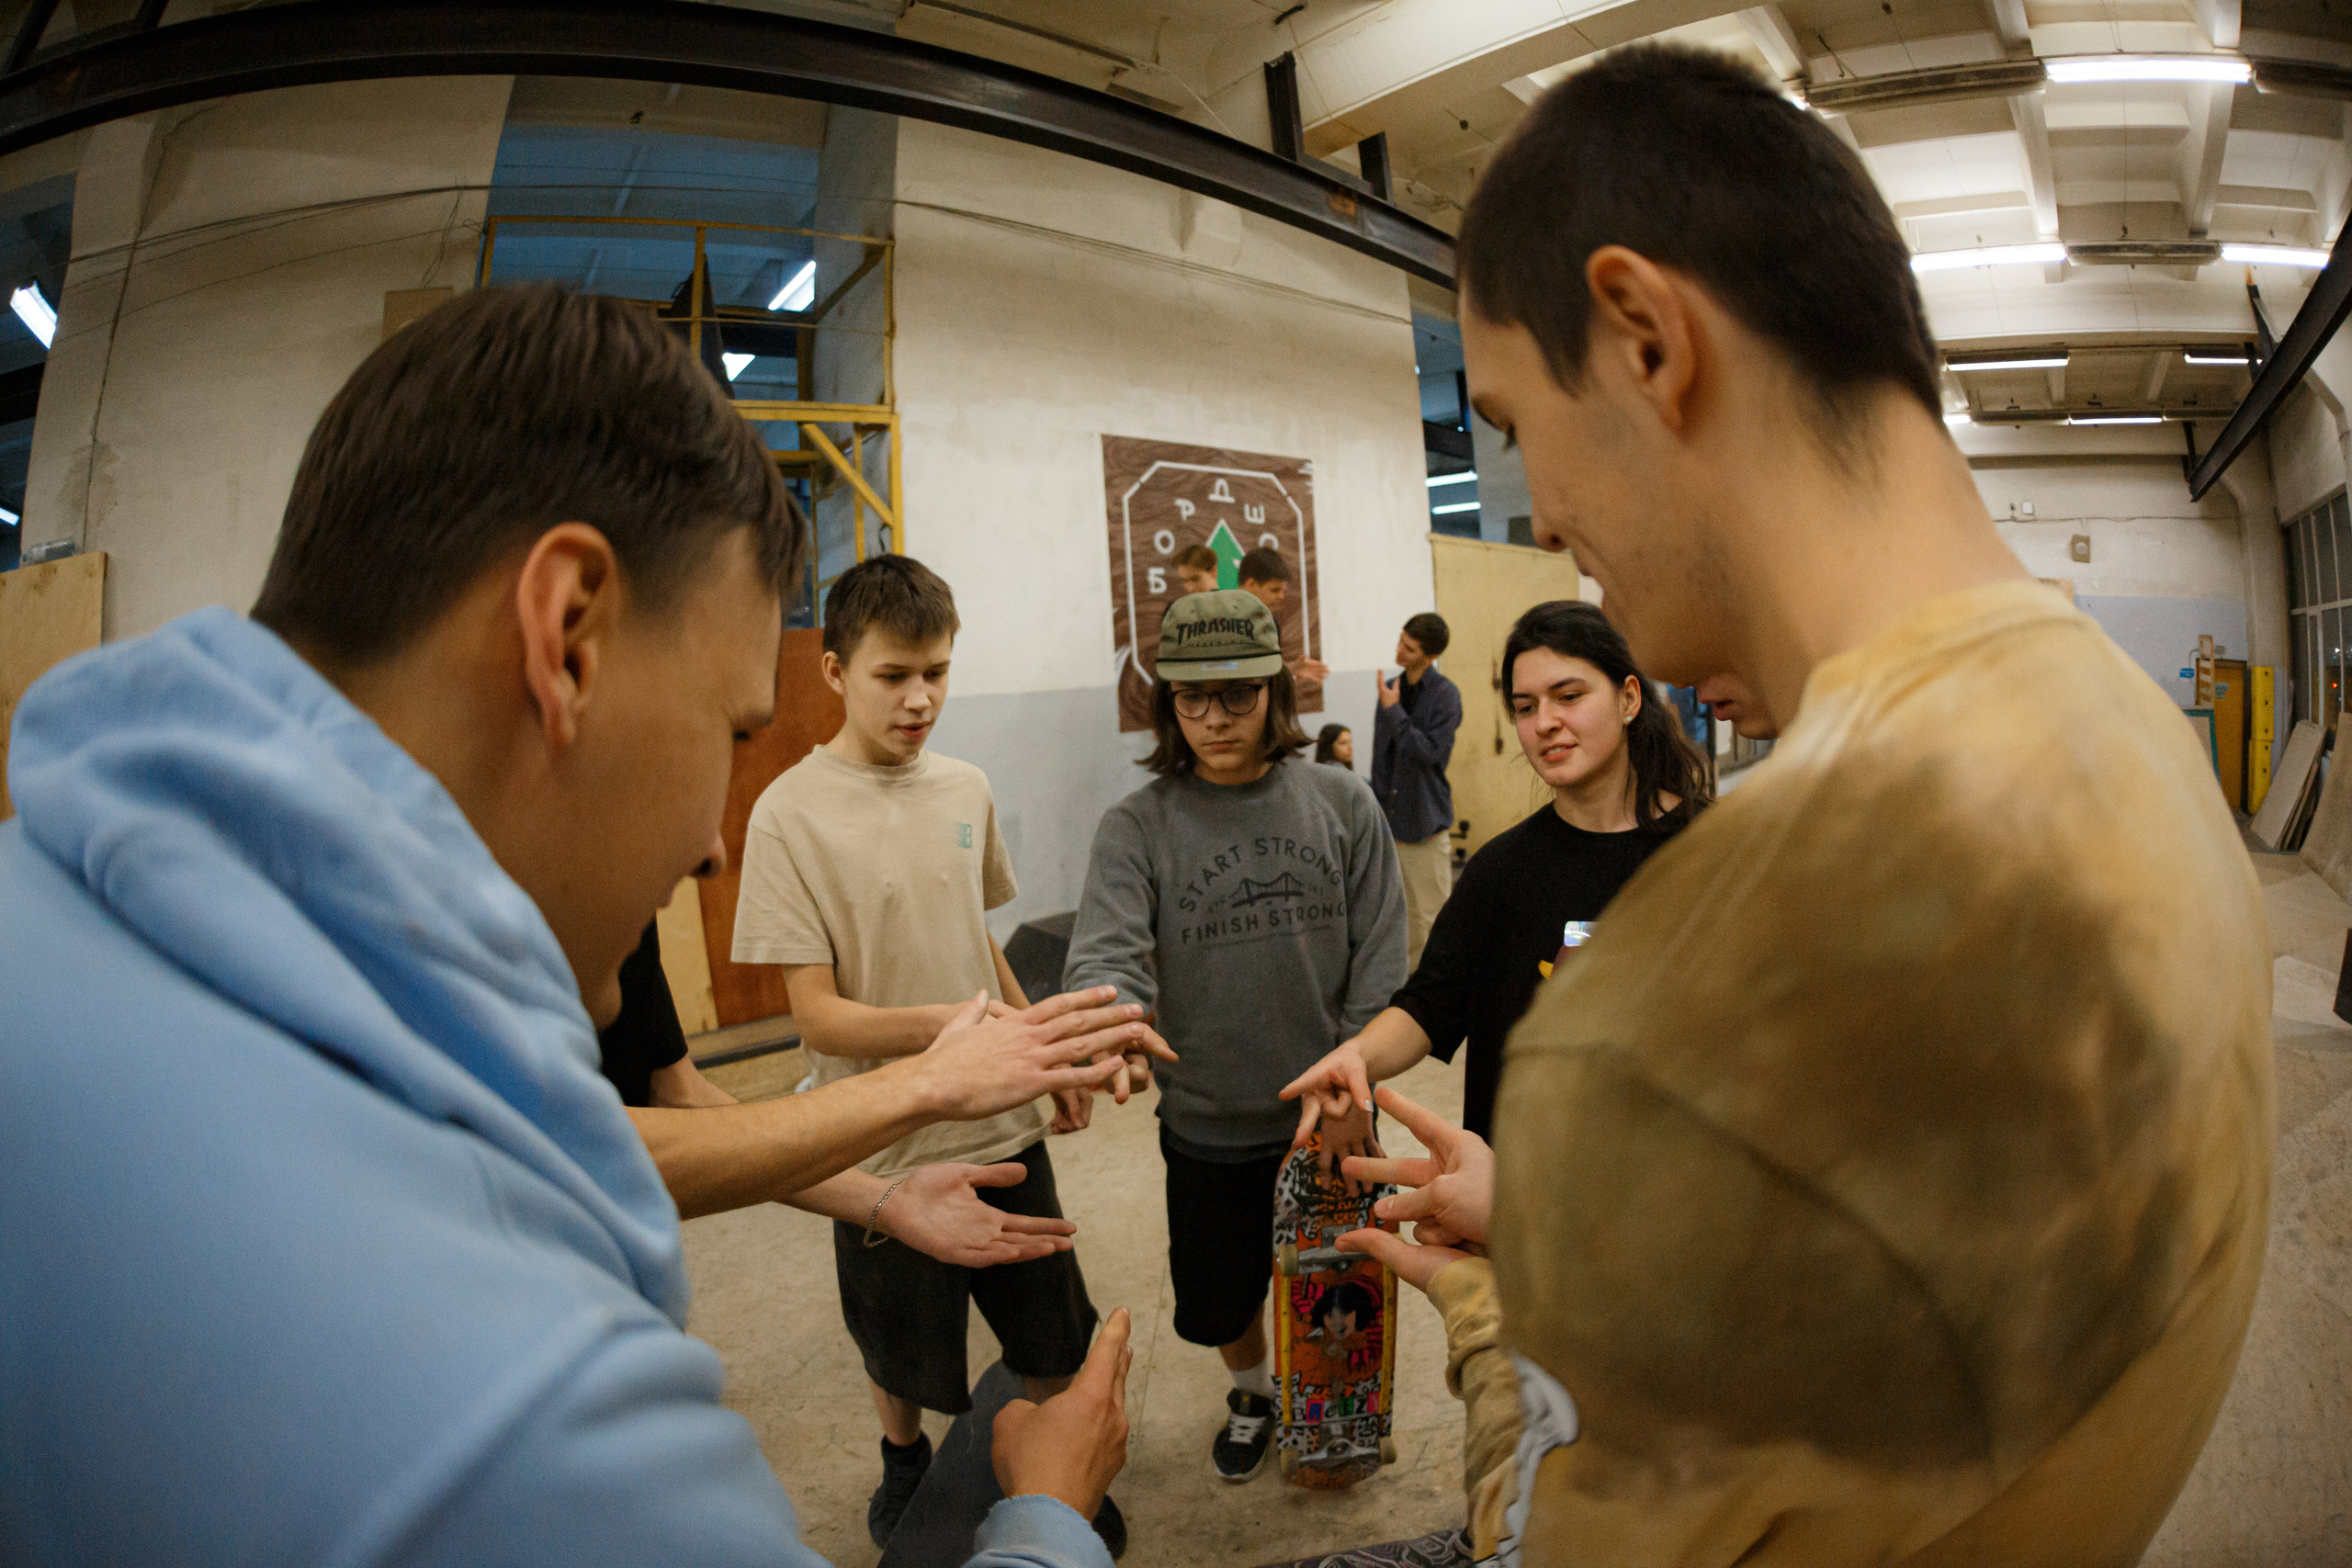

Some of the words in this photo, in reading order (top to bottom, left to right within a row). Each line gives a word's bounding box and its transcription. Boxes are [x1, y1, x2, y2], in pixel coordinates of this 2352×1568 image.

[1148, 479, 1279, 594] БОРДШО
[1177, 617, 1255, 647] THRASHER
[1179, 844, 1242, 912] START
[1255, 837, 1342, 886] STRONG
[1182, 914, 1259, 944] FINISH
